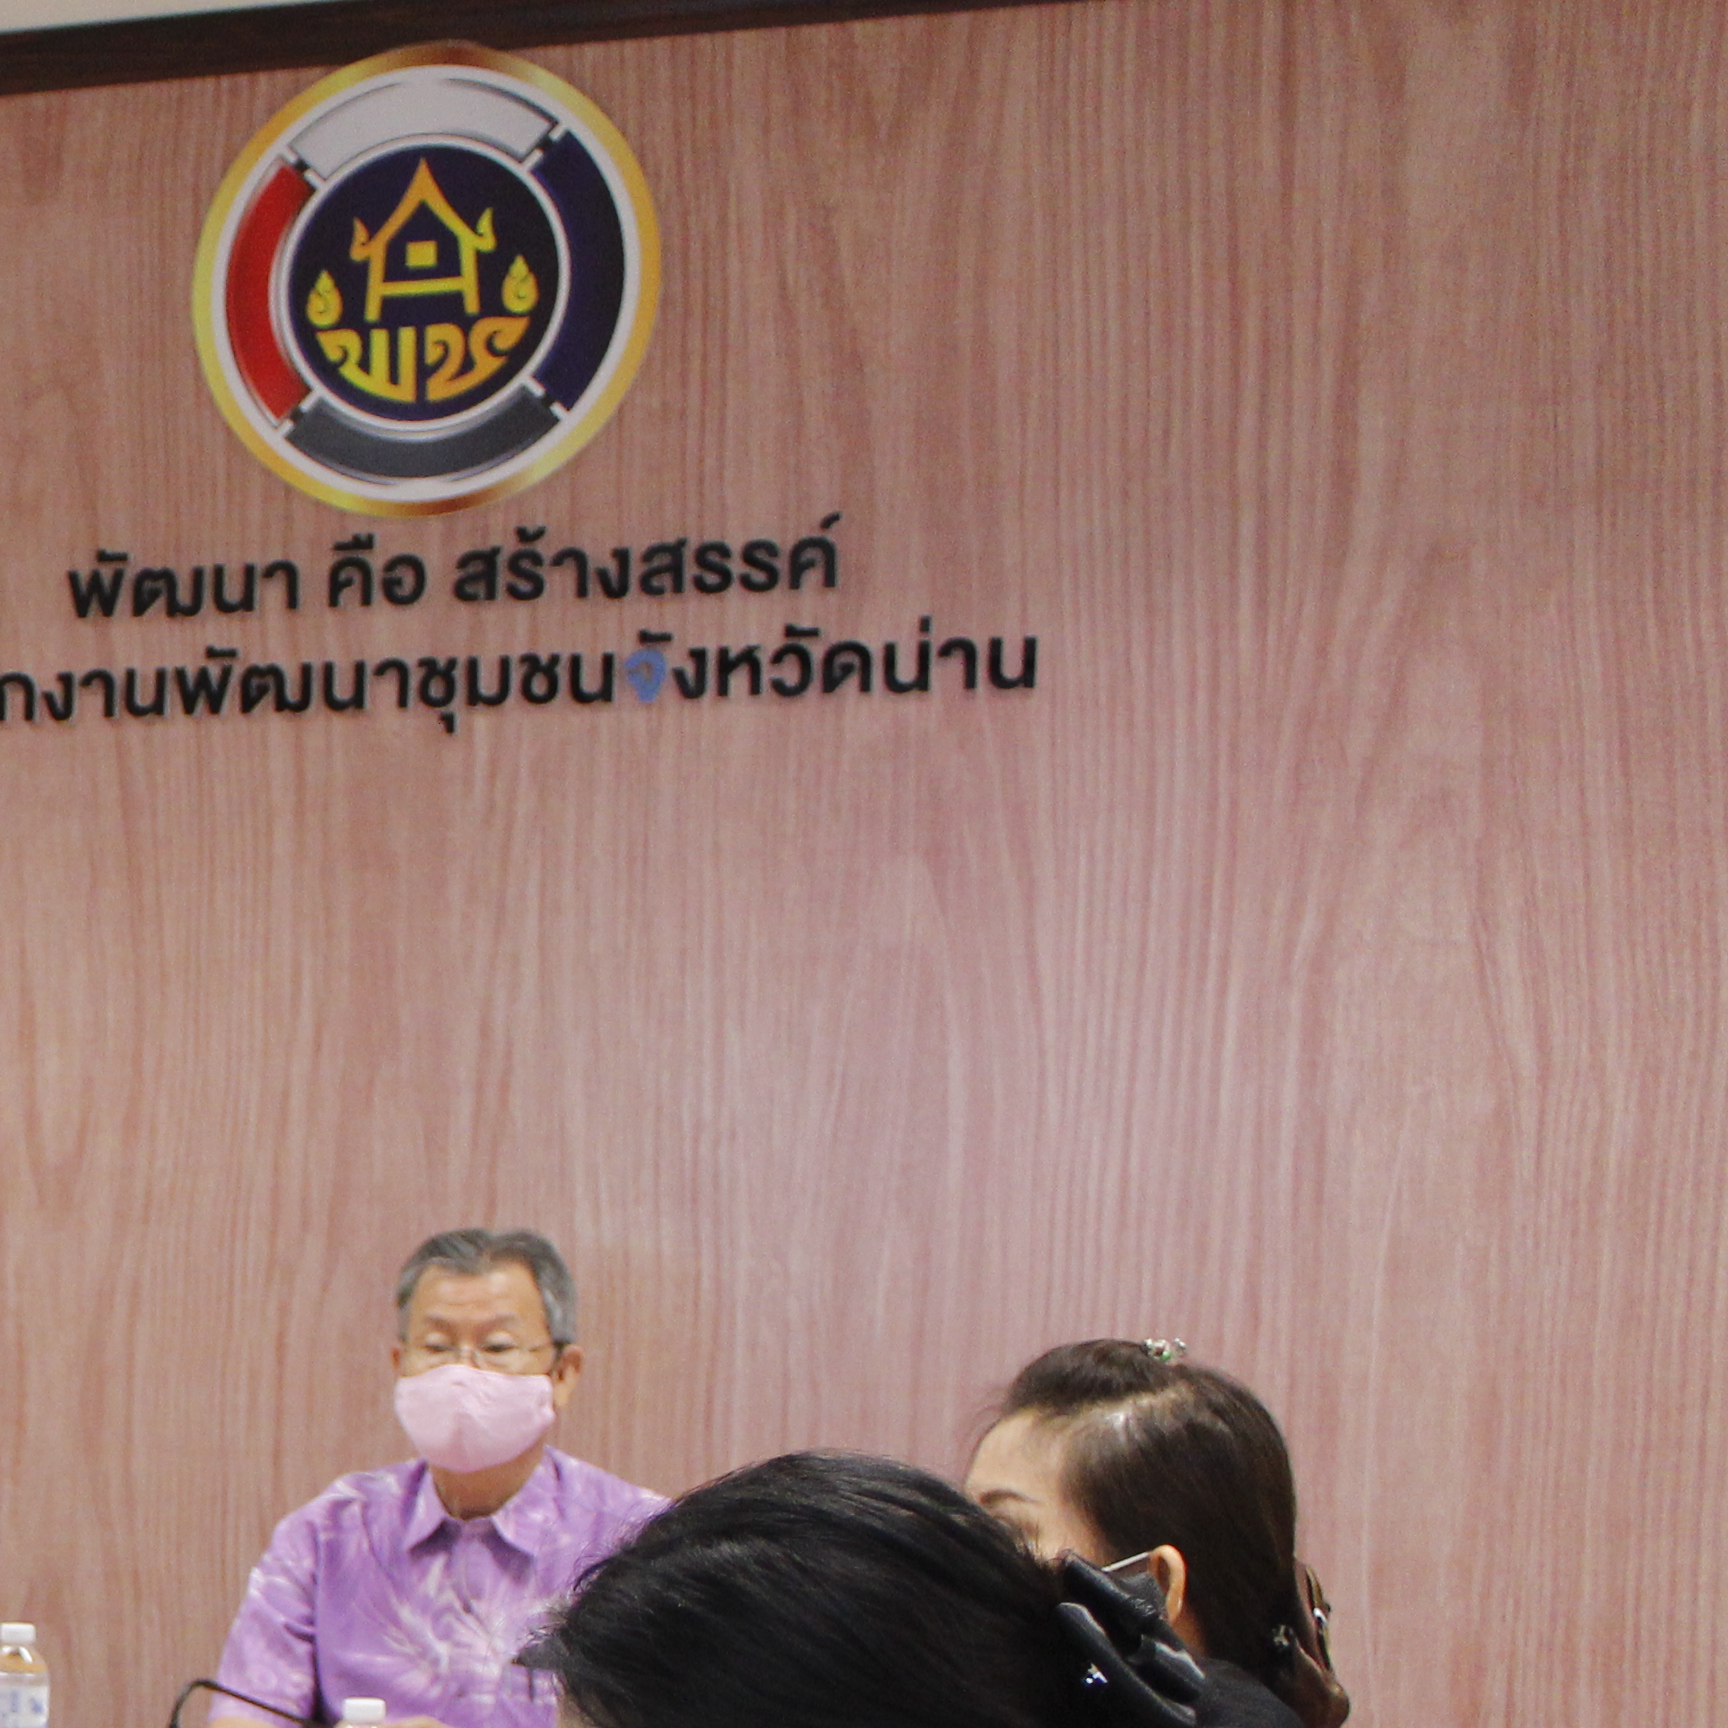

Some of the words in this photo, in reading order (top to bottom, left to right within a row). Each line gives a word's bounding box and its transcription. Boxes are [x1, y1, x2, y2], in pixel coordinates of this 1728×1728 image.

[68, 550, 300, 621] พัฒนา
[327, 533, 427, 610] คือ
[453, 514, 840, 604] สร้างสรรค์
